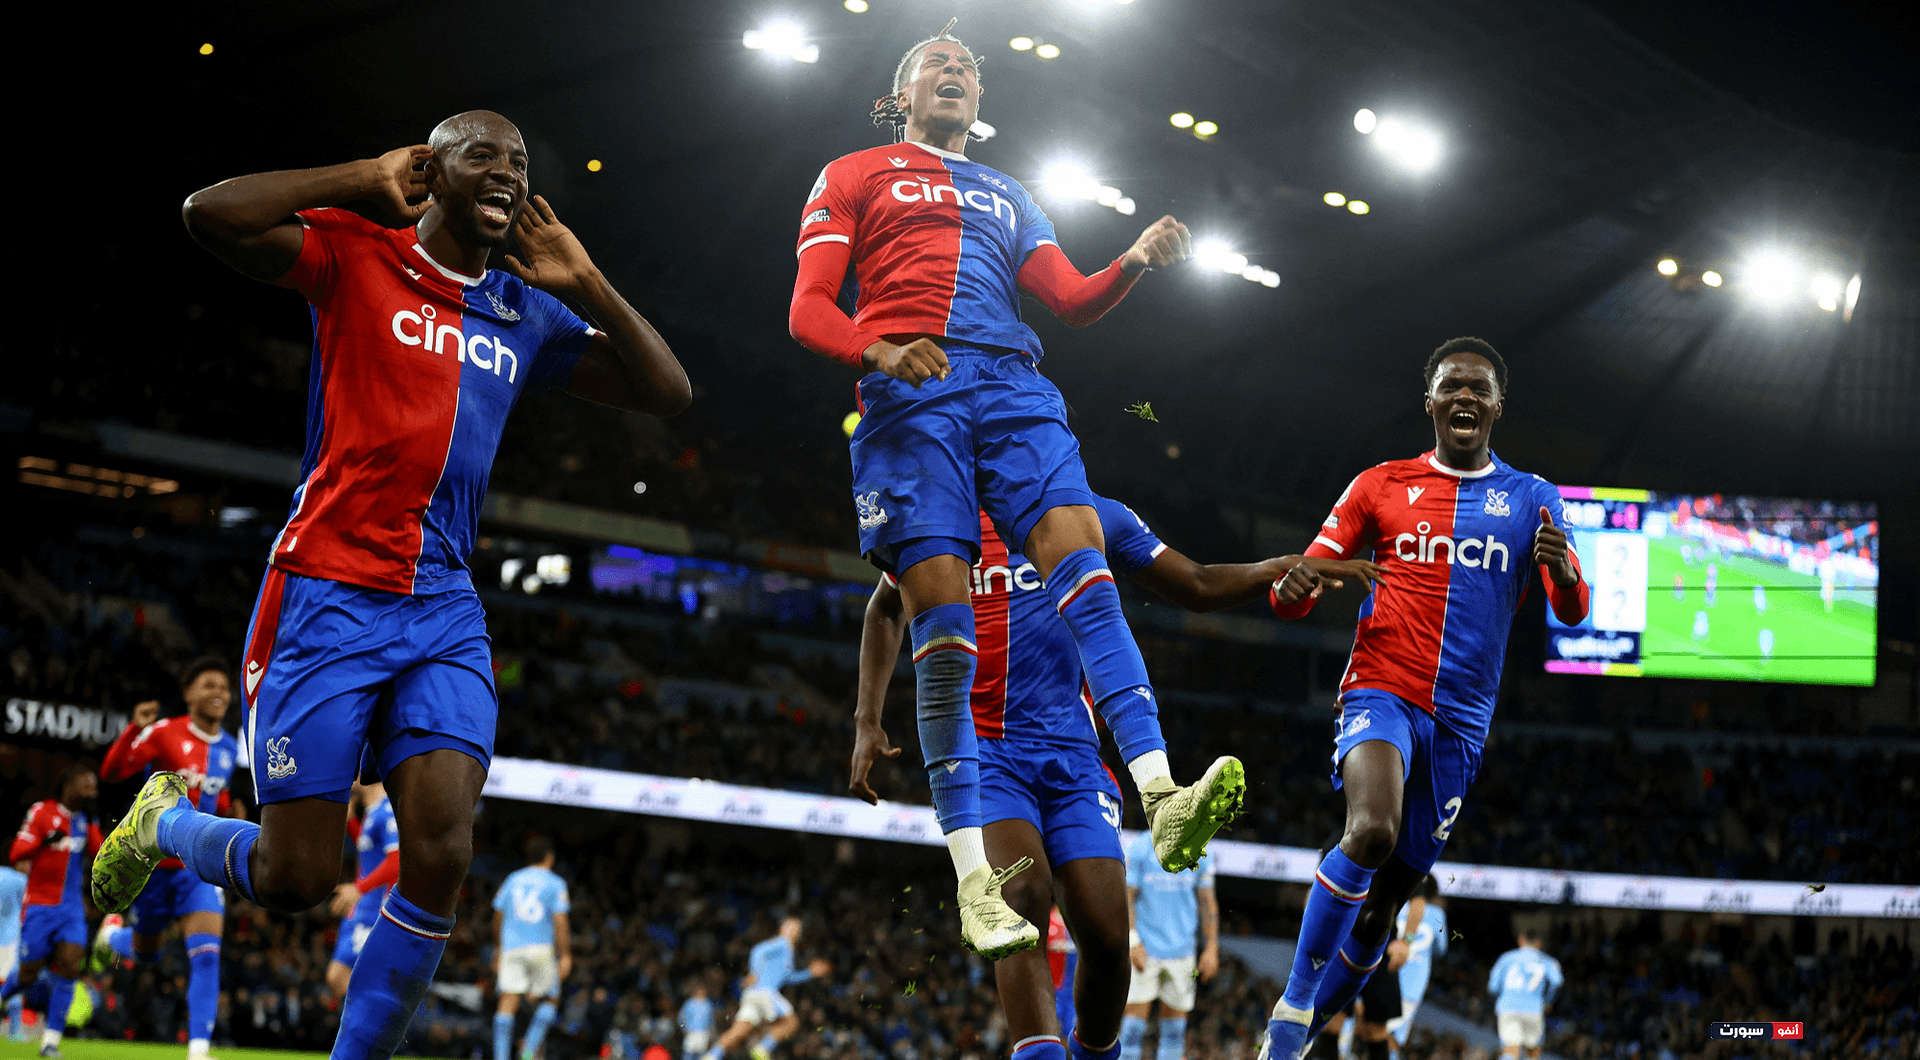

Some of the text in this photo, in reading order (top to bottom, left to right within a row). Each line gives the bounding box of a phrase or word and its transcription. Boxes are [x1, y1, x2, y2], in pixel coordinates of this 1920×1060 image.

[891, 174, 1017, 232] cinch
[392, 303, 518, 384] cinch
[1395, 521, 1509, 572] cinch
[970, 557, 1047, 595] inc
[1096, 790, 1120, 828] 5
[1431, 796, 1462, 841] 2
